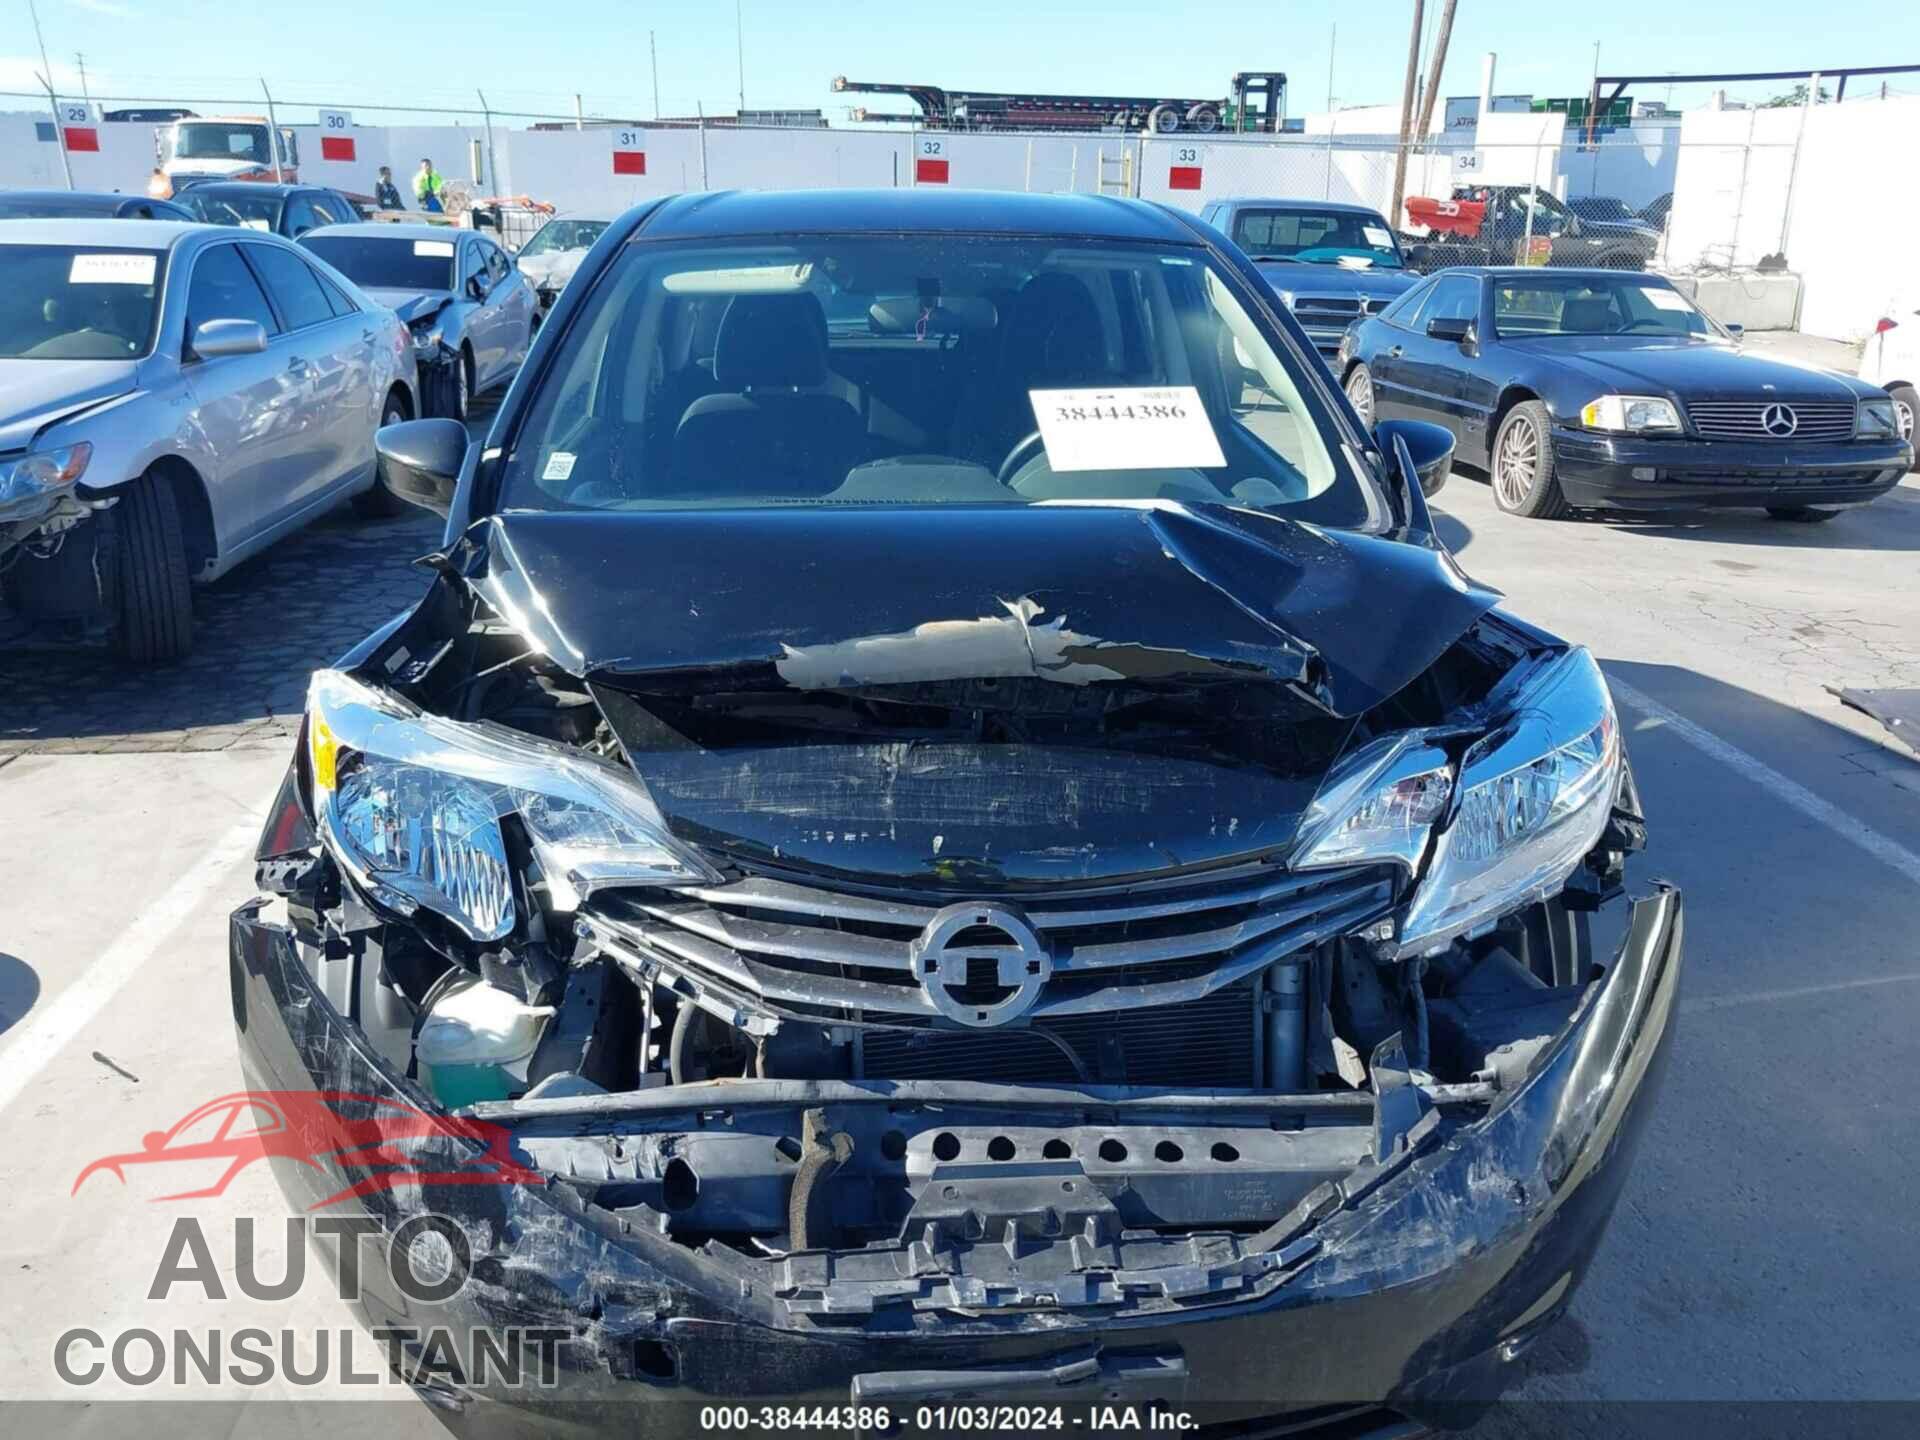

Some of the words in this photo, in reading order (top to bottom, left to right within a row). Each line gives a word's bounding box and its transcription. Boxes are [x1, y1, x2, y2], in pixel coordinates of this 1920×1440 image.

[68, 108, 86, 122] 29
[327, 115, 345, 129] 30
[621, 132, 637, 145] 31
[924, 141, 941, 154] 32
[1179, 148, 1196, 162] 33
[1459, 155, 1476, 169] 34
[1056, 405, 1187, 423] 38444386
